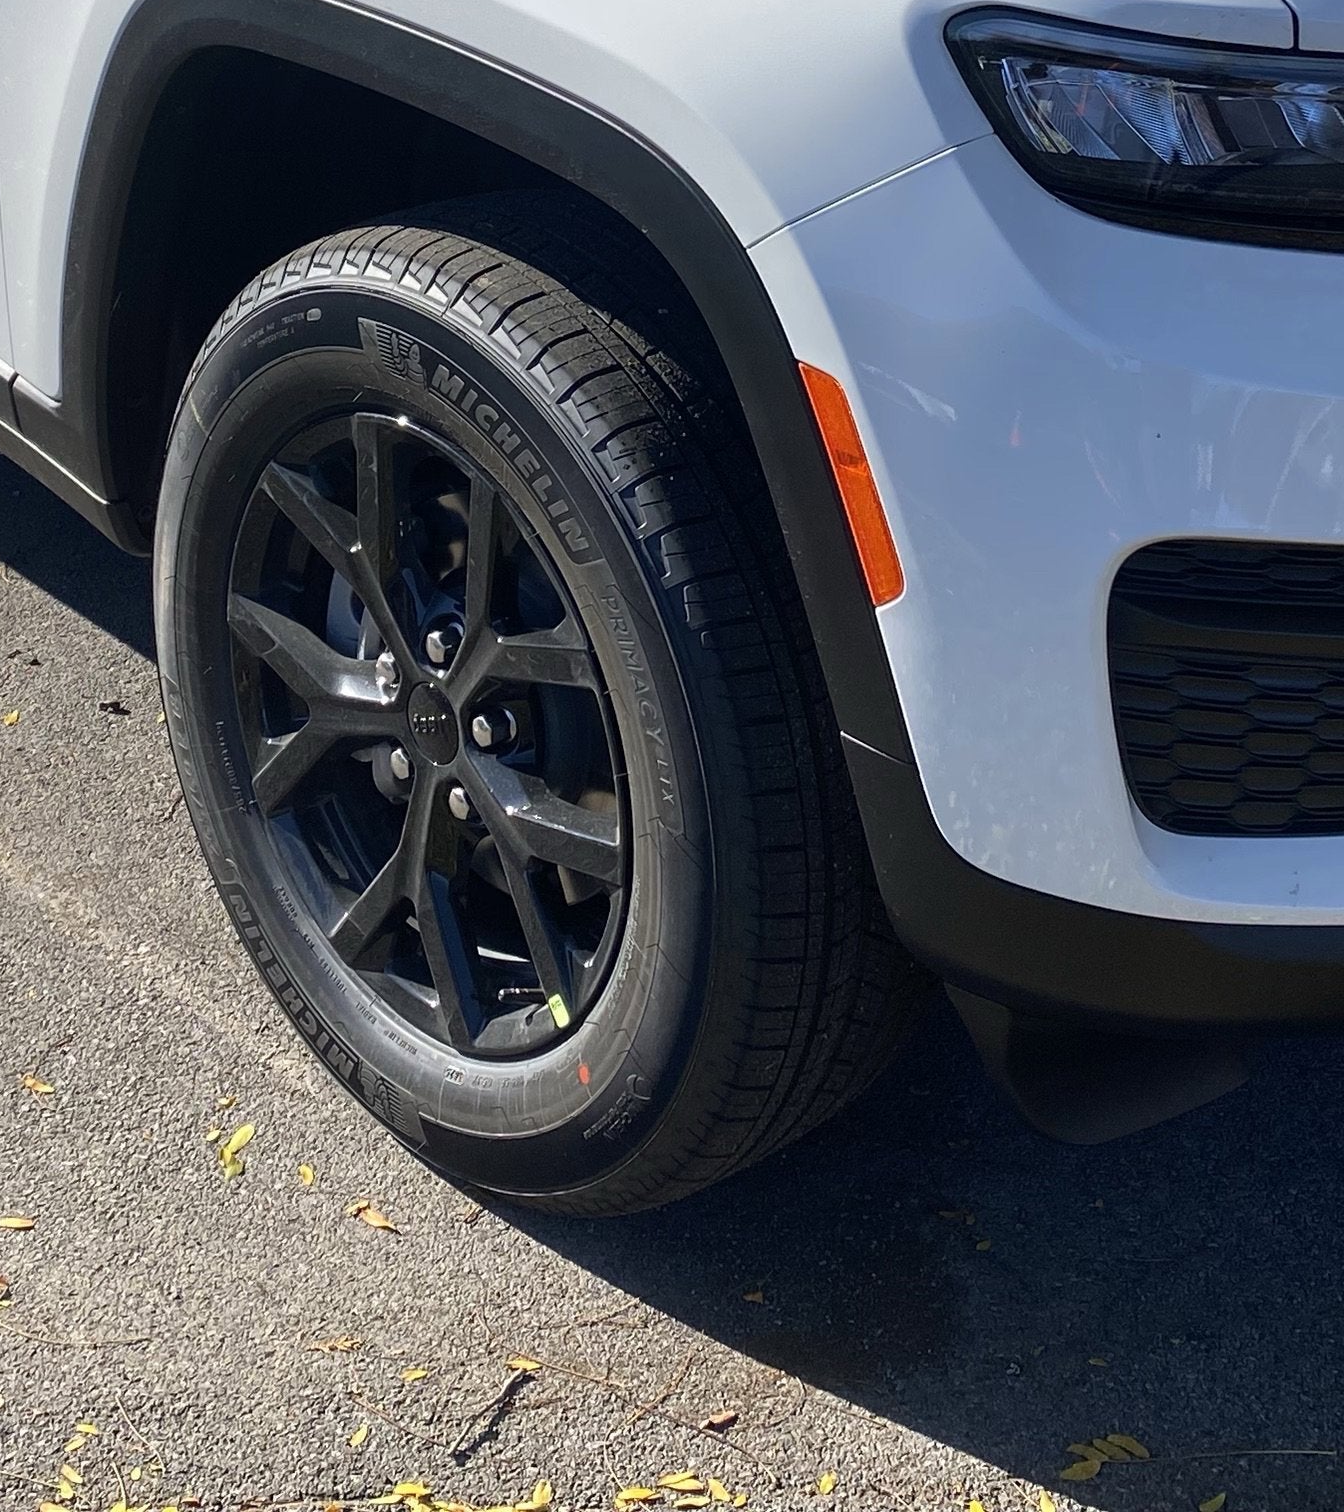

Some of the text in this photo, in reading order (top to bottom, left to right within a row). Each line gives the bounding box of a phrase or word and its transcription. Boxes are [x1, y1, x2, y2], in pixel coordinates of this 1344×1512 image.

[431, 363, 590, 553] MICHELIN
[601, 595, 675, 806] PRIMACY LTX
[232, 894, 355, 1080] MICHELIN
